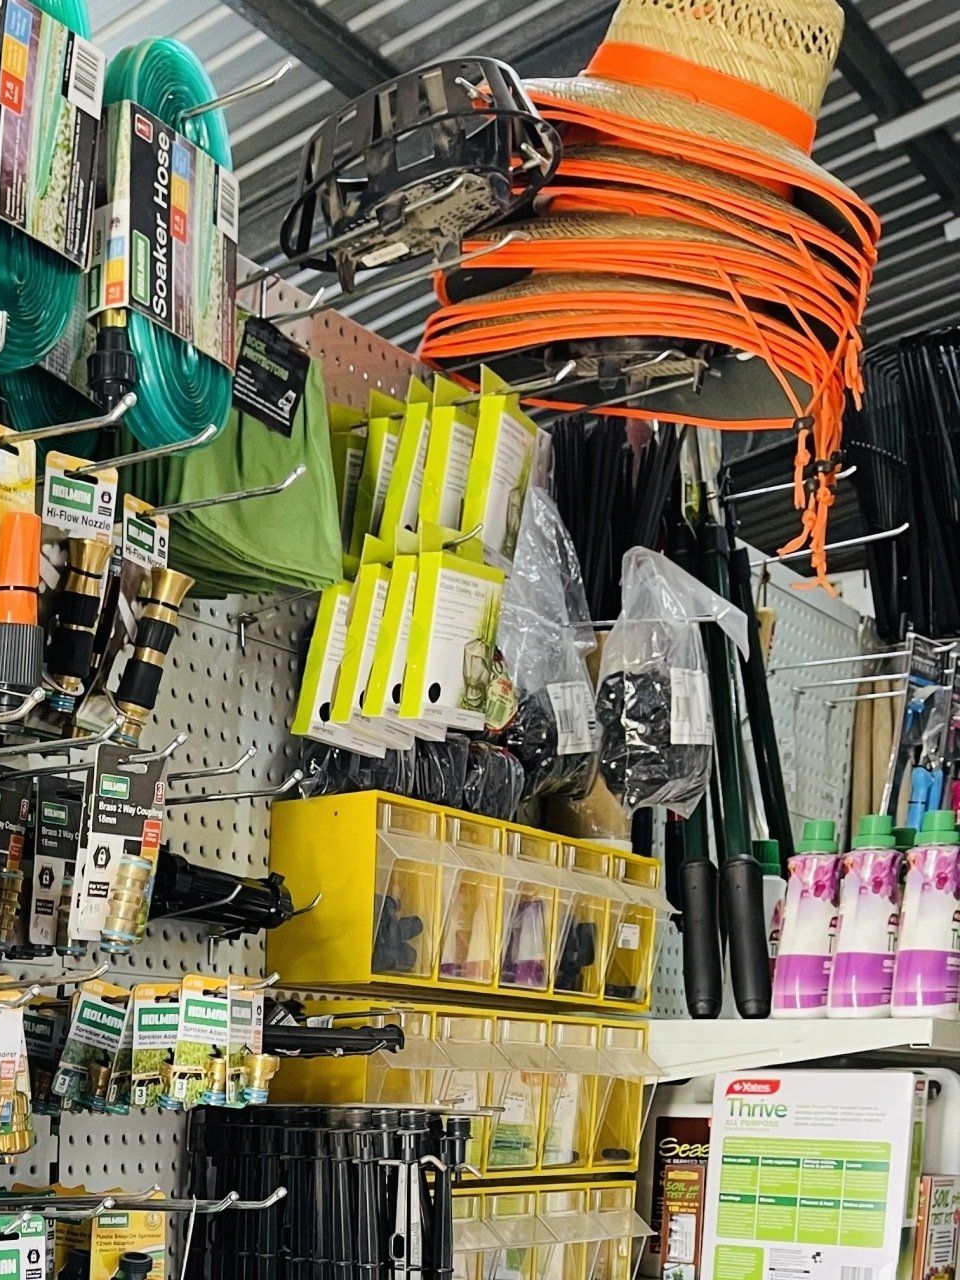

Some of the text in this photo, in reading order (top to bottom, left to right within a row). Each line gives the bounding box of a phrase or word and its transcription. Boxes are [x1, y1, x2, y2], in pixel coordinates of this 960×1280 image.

[153, 131, 170, 318] Soaker Hose
[46, 506, 111, 530] Hi-Flow Nozzle
[98, 802, 163, 819] Brass 2 Way Coupling
[138, 1088, 144, 1098] 3
[177, 1081, 184, 1091] 3
[741, 1082, 771, 1093] Yates
[727, 1098, 788, 1118] Thrive
[659, 1138, 710, 1157] Seas
[686, 1192, 696, 1200] KIT
